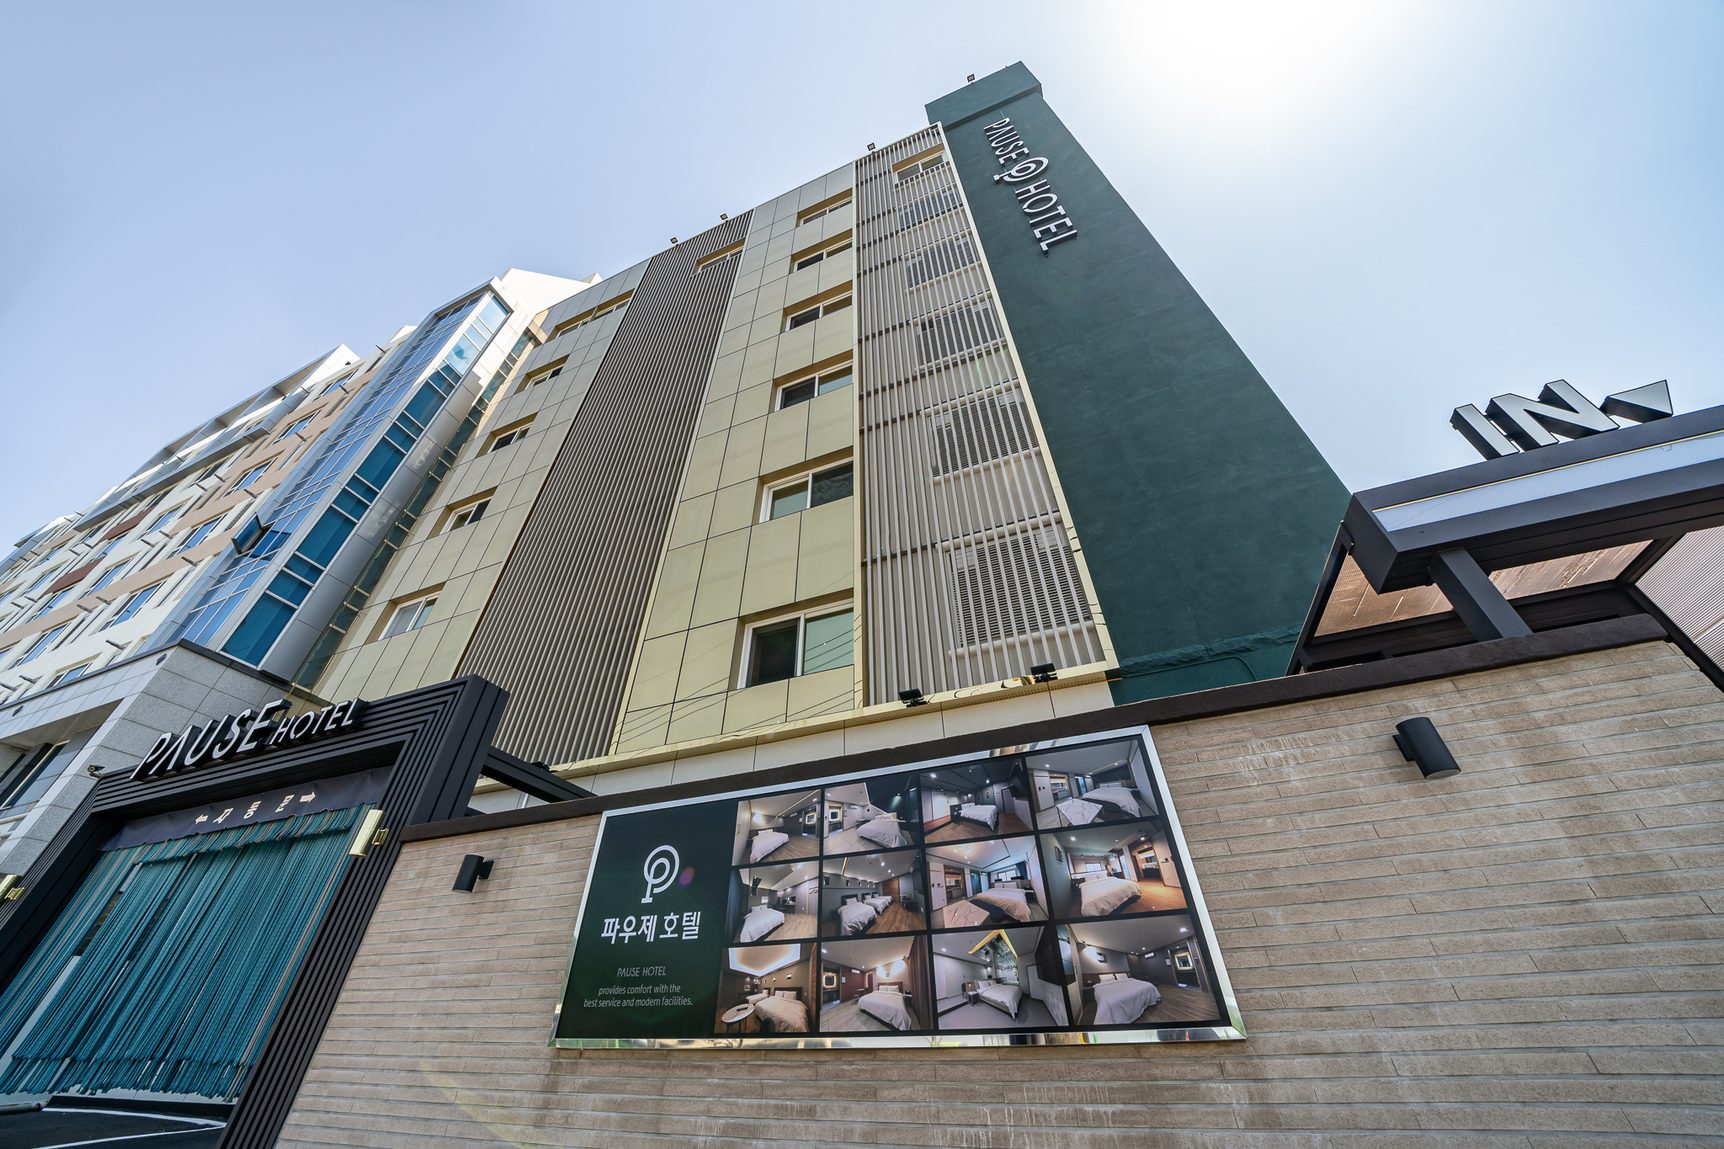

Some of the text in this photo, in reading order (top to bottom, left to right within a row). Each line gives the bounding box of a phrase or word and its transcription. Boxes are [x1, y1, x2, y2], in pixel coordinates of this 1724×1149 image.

[983, 117, 1030, 165] PAUSE
[1015, 179, 1078, 252] HOTEL
[1454, 378, 1621, 457] IN
[130, 698, 361, 780] PAUSE HOTEL
[601, 911, 701, 945] 파우제 호텔
[616, 965, 667, 978] PAUSE HOTEL
[583, 995, 693, 1008] best service and modern facilities.
[598, 983, 681, 997] provides comfort with the
